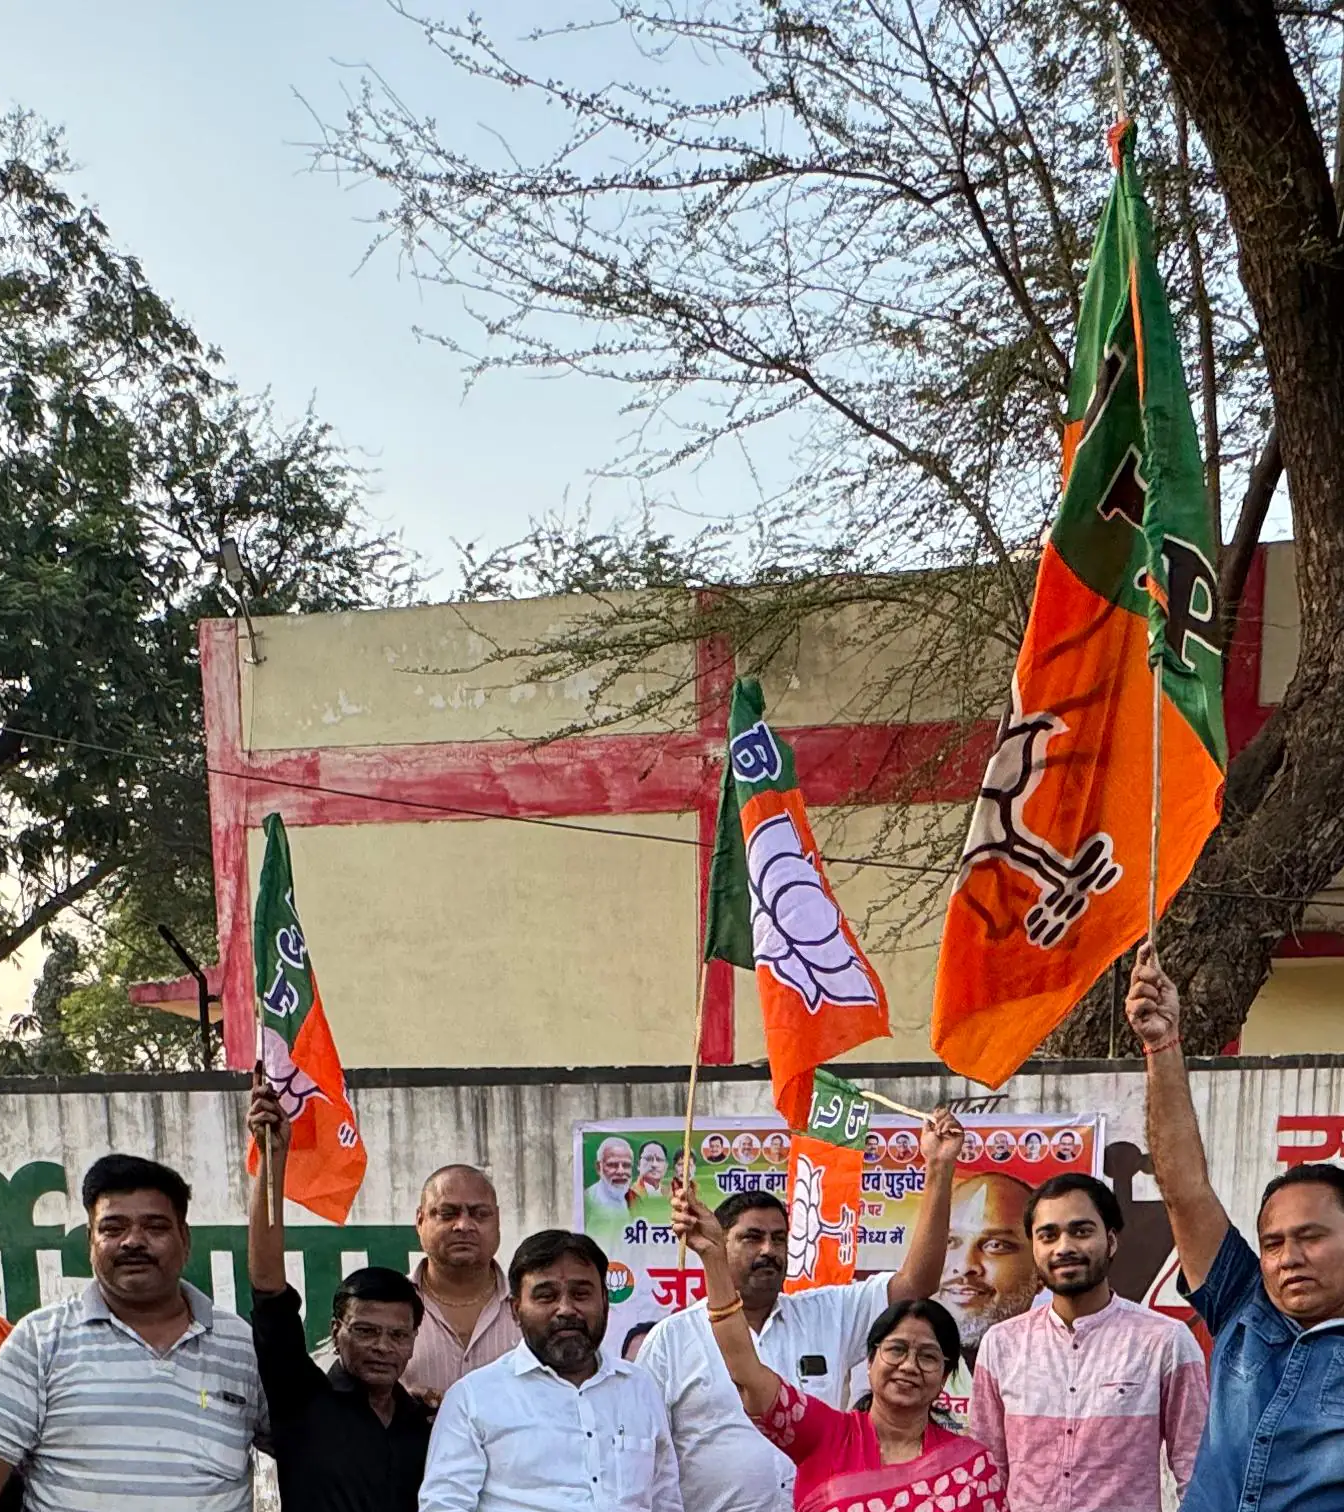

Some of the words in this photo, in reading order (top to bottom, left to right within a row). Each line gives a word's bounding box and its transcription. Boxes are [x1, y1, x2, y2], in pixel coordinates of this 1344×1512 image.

[717, 1168, 762, 1192] पश्चिम
[862, 1167, 881, 1191] एवं
[624, 1219, 648, 1244] श्री
[889, 1226, 905, 1244] में
